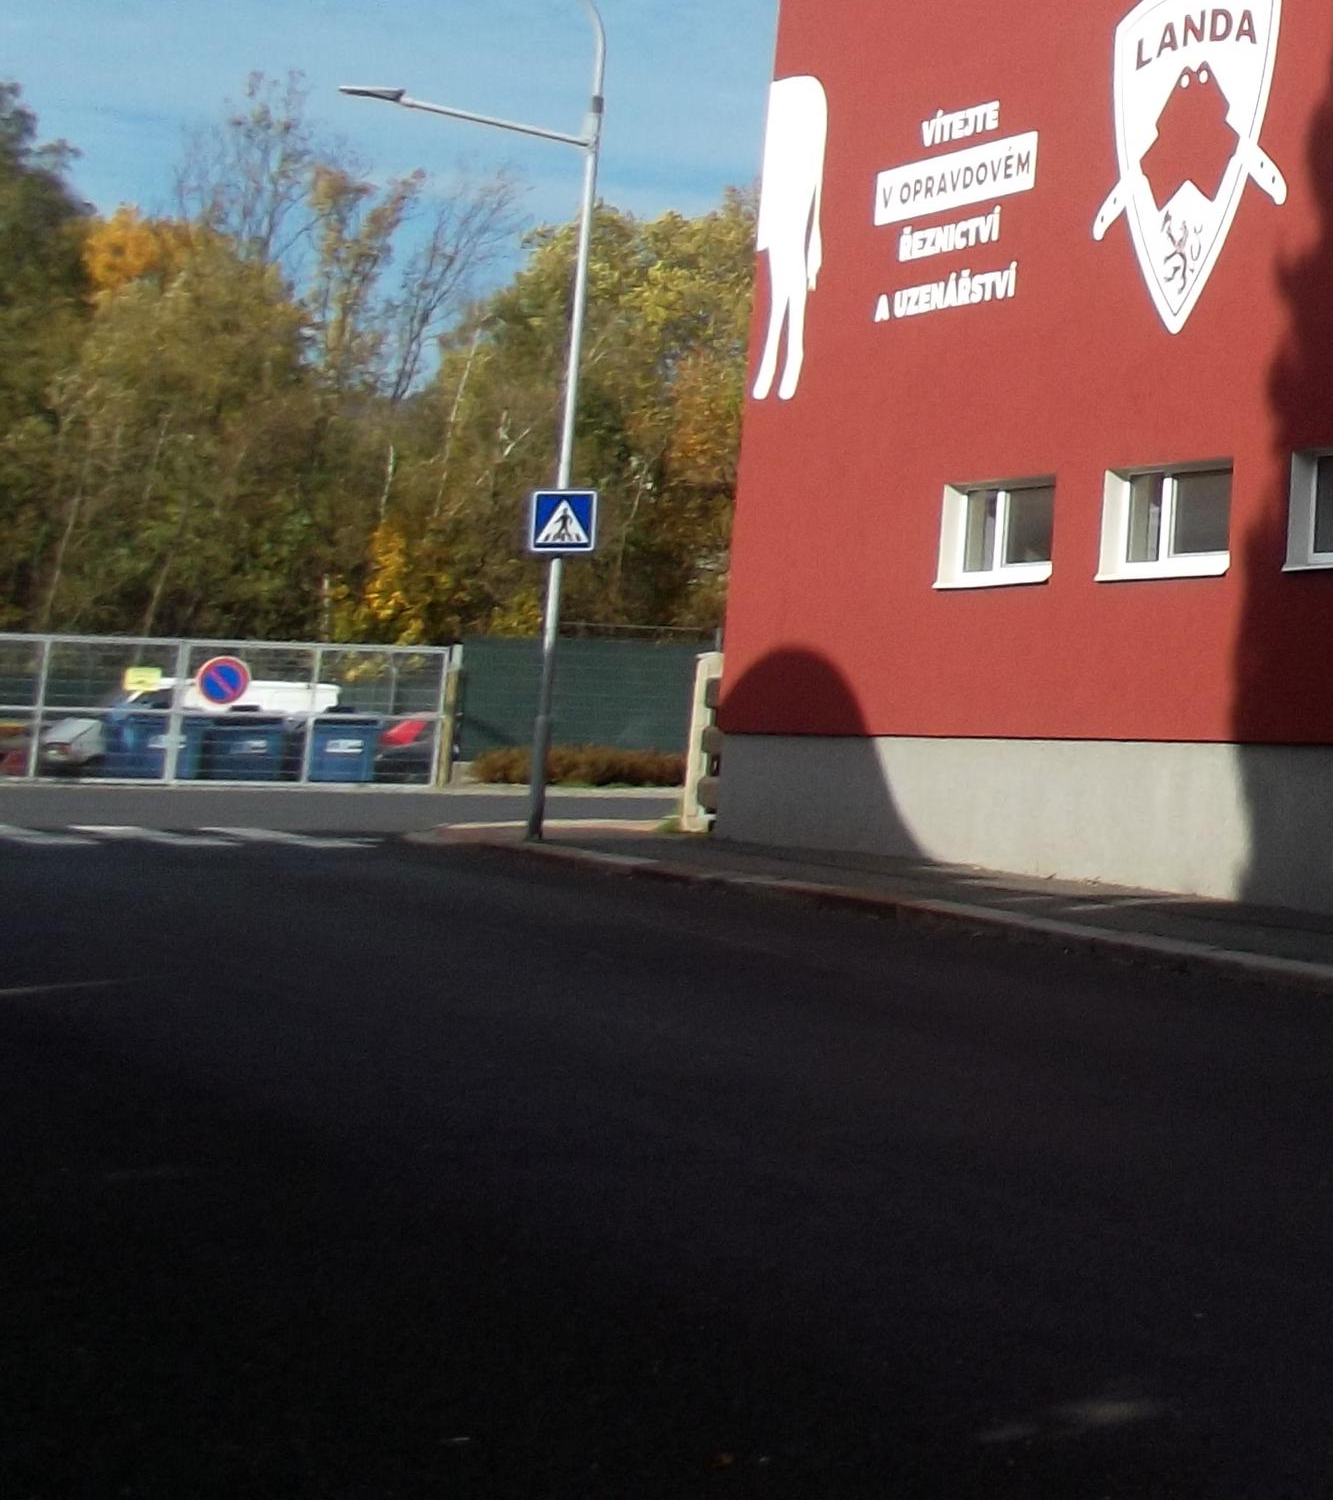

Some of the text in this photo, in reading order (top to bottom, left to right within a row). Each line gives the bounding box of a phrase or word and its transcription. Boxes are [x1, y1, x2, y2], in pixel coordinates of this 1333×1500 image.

[1136, 8, 1257, 70] LANDA
[921, 100, 1000, 147] VÍTEJTE
[882, 146, 1030, 208] V OPRAVDOVÉM
[898, 205, 1001, 262] ŘEZNICTVÍ
[874, 261, 1017, 322] A UZENÁŘSTVÍ
